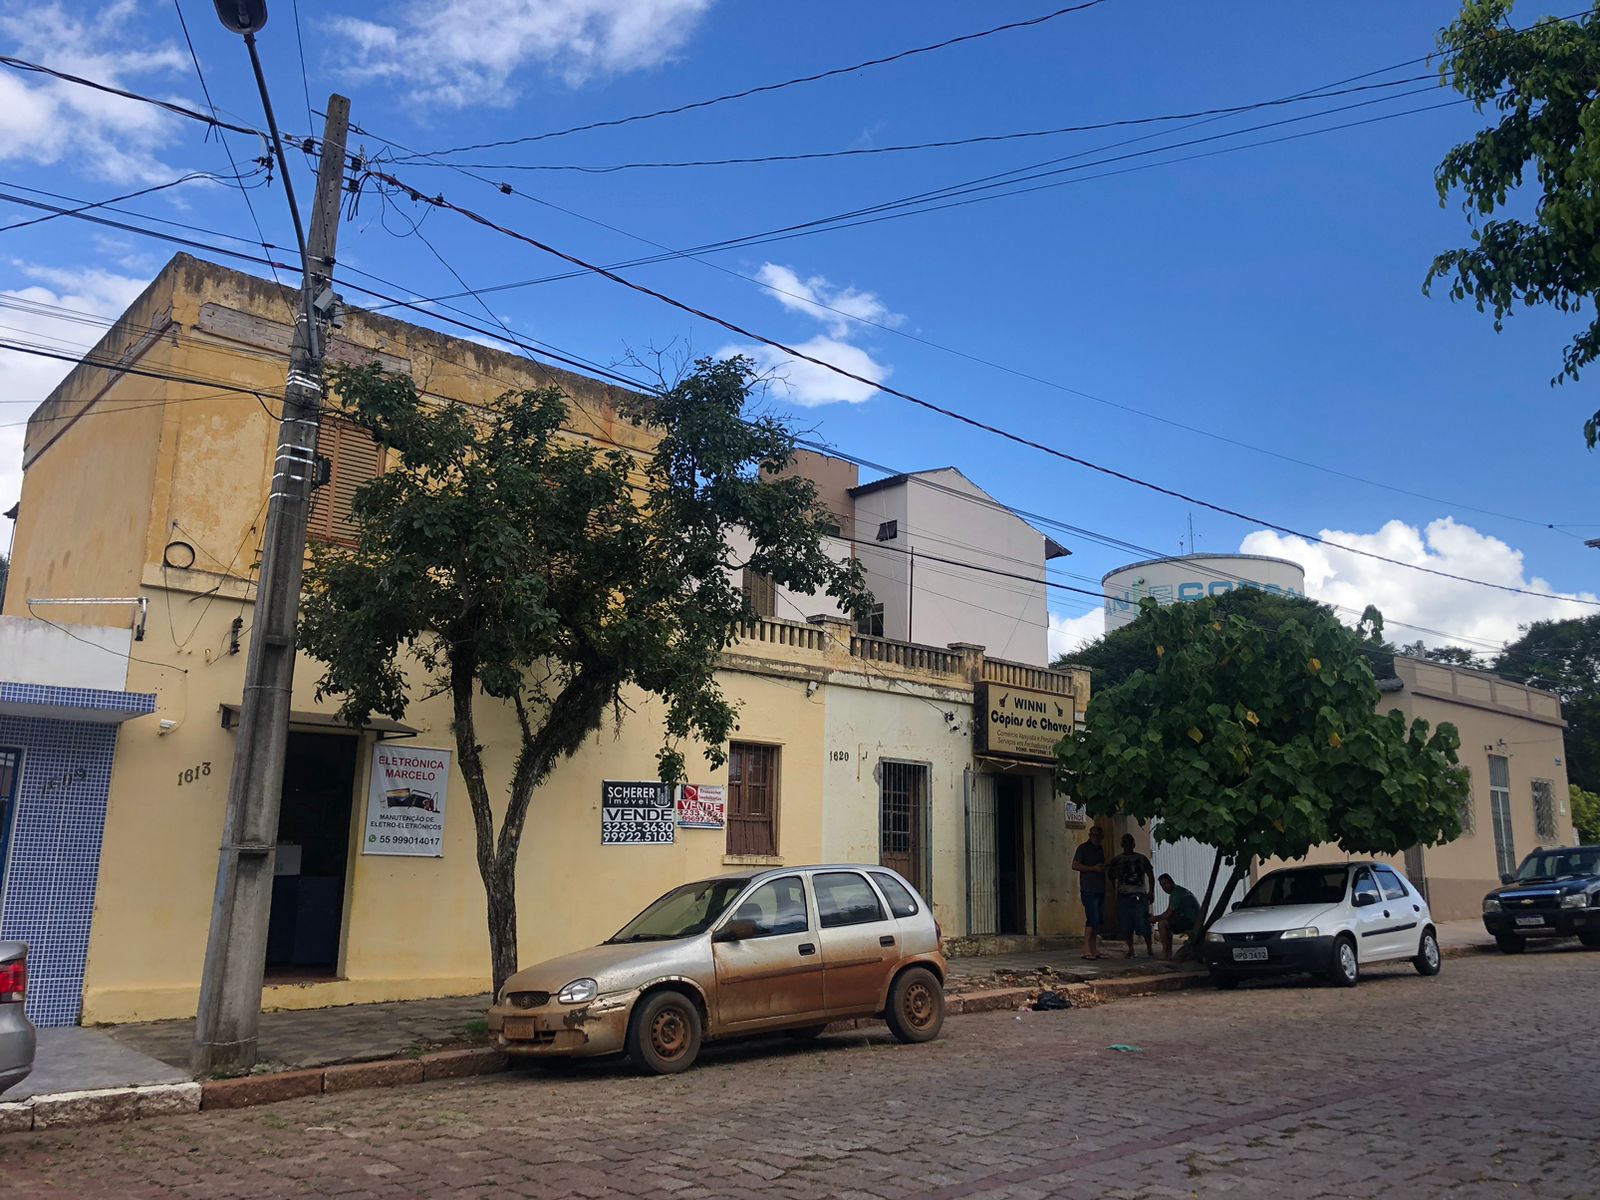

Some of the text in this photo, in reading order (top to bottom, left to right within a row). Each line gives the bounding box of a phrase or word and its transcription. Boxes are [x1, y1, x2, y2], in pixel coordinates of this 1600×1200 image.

[1014, 697, 1046, 714] WINNI
[991, 710, 1071, 733] Cópias de Chaves
[830, 750, 849, 762] 1620
[177, 762, 211, 786] 1613
[386, 769, 436, 781] MARCELO
[608, 786, 655, 798] SCHERER
[681, 800, 720, 811] VENDE
[606, 809, 672, 821] VENDE
[603, 822, 673, 832] 3233-3630
[380, 835, 440, 845] 55 999014017
[603, 832, 673, 842] 99922.5103
